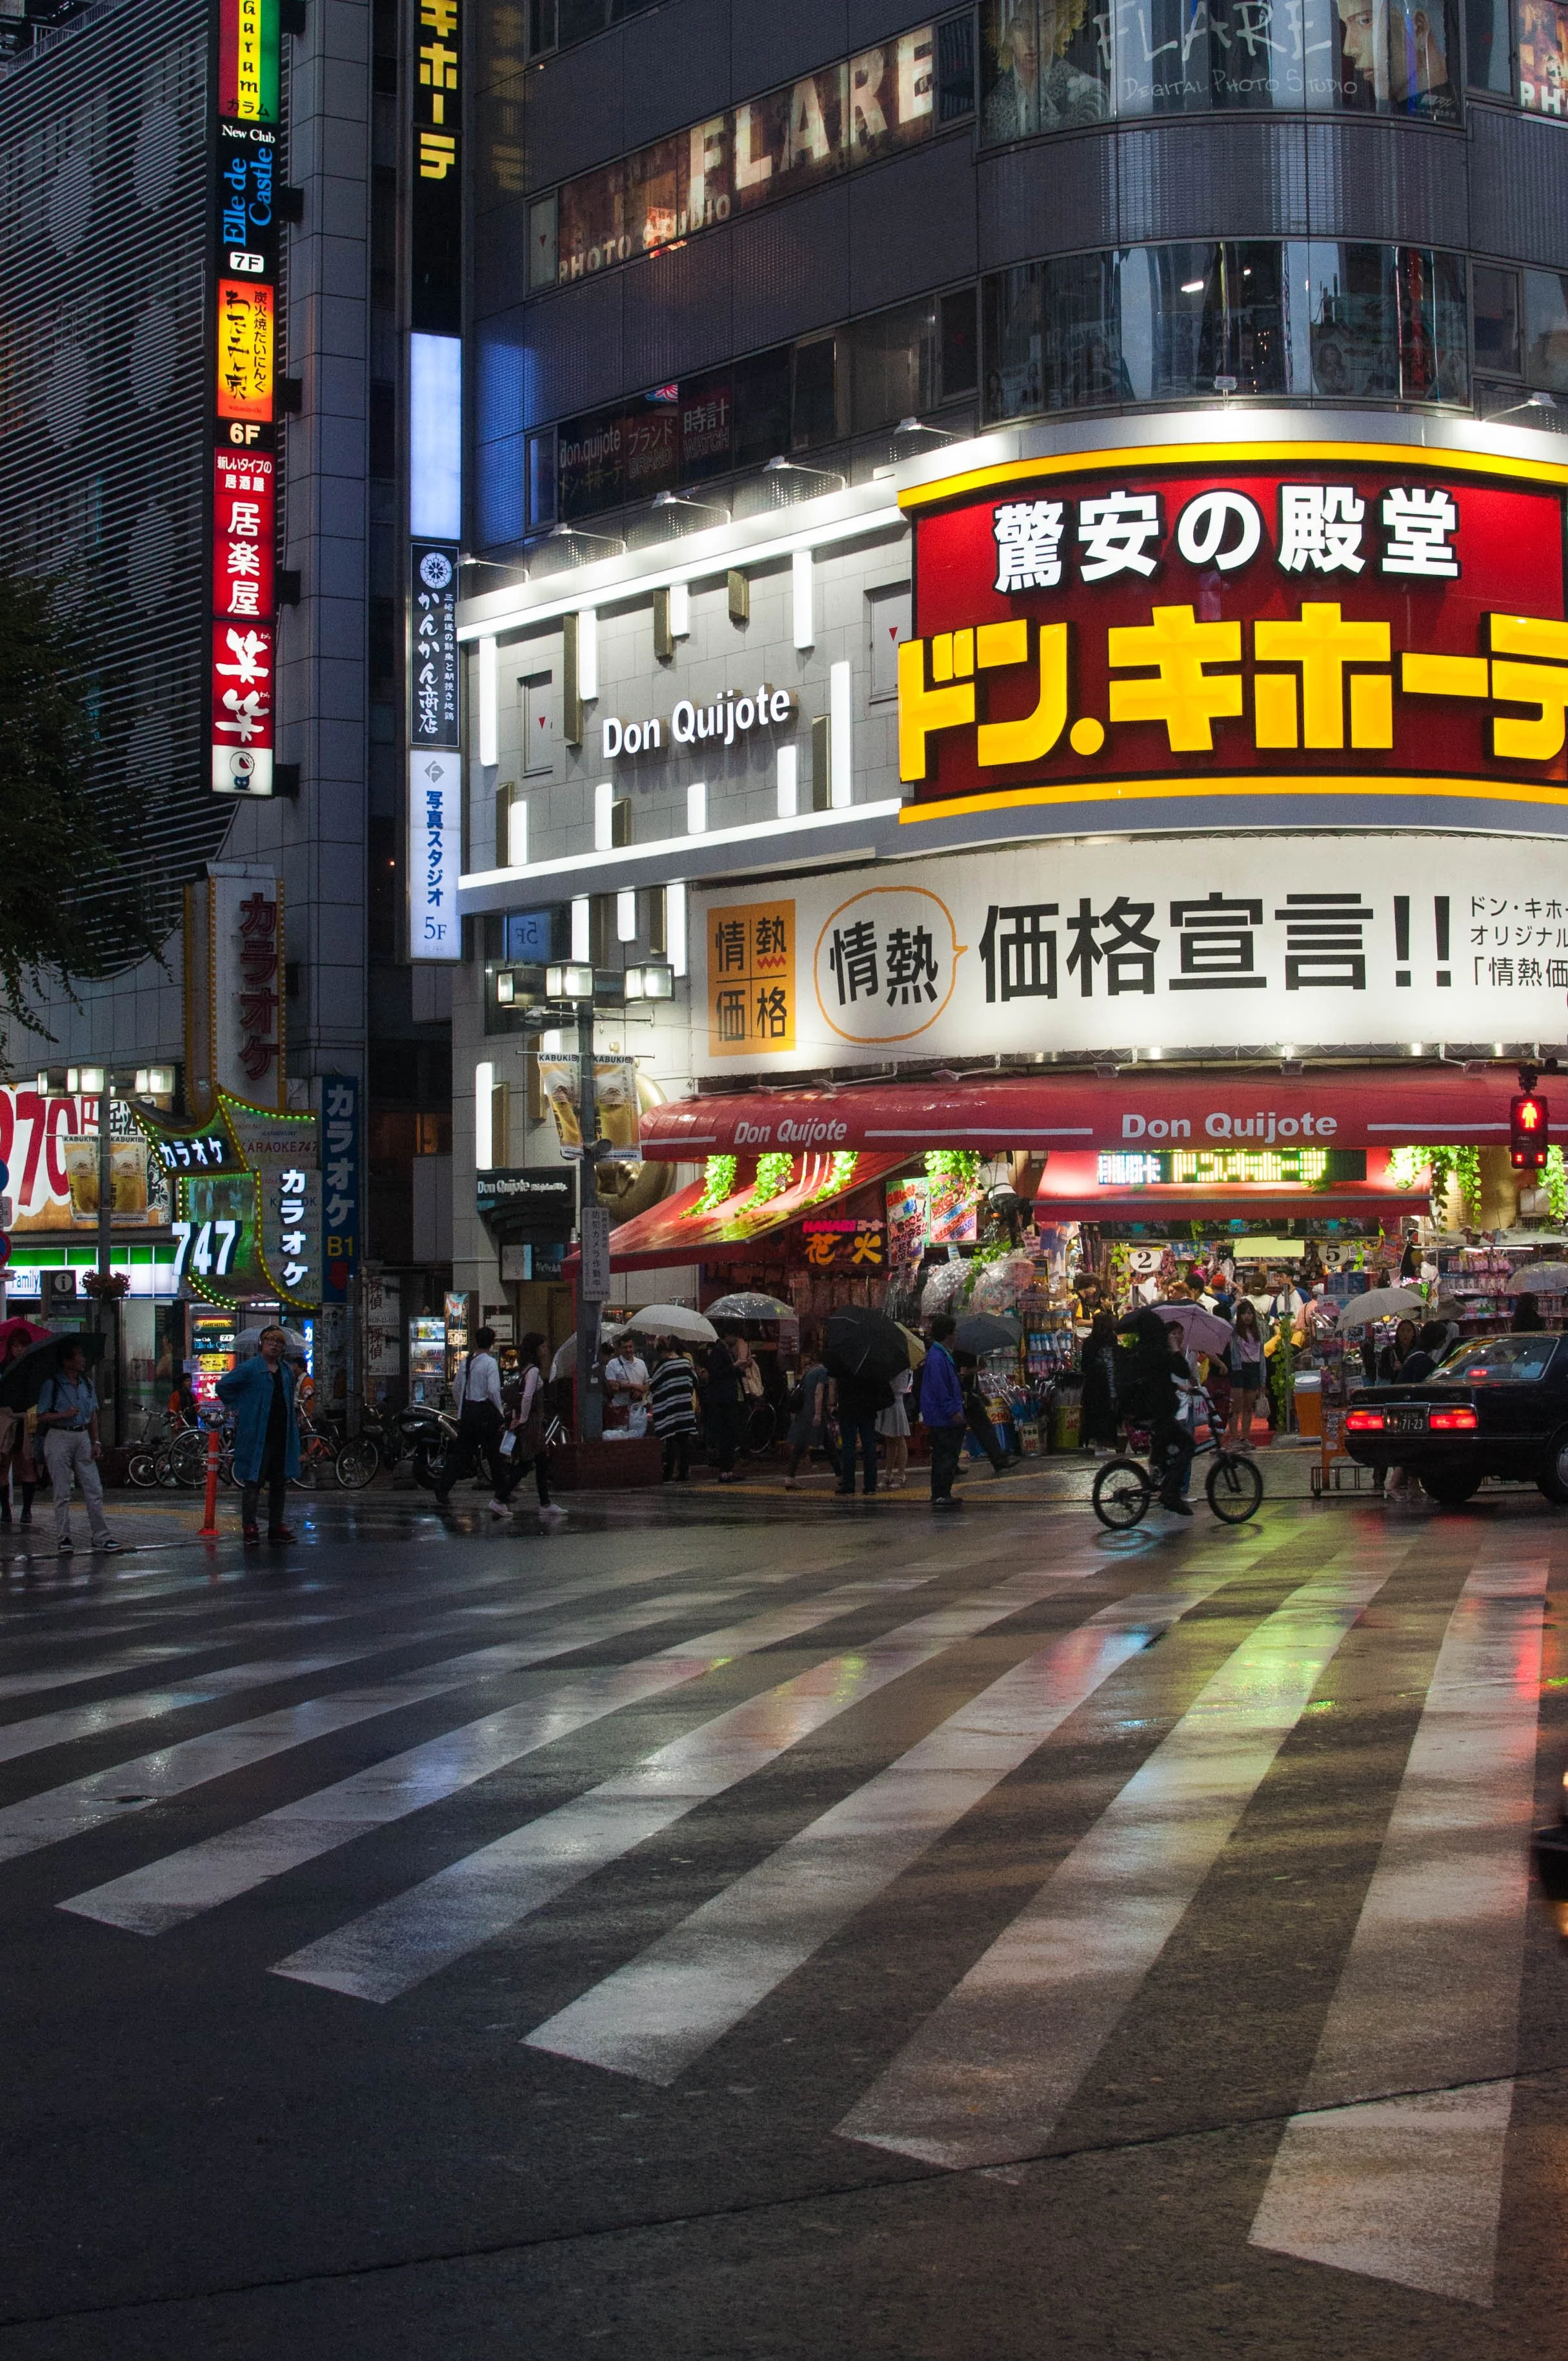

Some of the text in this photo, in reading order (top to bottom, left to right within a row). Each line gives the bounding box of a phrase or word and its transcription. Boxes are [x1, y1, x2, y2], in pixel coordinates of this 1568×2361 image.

[239, 0, 258, 94] Garam
[1091, 0, 1332, 70] FLARE
[1212, 70, 1279, 95] PHOTO
[1286, 69, 1358, 94] STUDIO
[1520, 81, 1568, 115] PH
[227, 97, 270, 117] ガラム
[689, 25, 934, 208] FLARE
[221, 125, 276, 143] New Club
[223, 158, 246, 246] Elle de
[248, 148, 273, 226] Castle
[234, 254, 261, 272] 7F
[559, 235, 632, 285] PHOTO
[225, 290, 251, 400] わたみん家
[254, 291, 267, 393] 炭火焼だいにんぐ
[683, 397, 730, 434] 時計
[230, 423, 261, 445] 6F
[628, 419, 674, 456] ブランド
[681, 428, 730, 461] WATCH
[217, 456, 272, 474] 新しいタイプの
[628, 447, 672, 479] BRAND
[225, 474, 265, 492] 居酒屋
[993, 484, 1460, 593] 驚安の殿堂
[227, 501, 261, 616] 居楽屋
[418, 592, 440, 734] かんかん商店
[215, 627, 269, 743] 笑笑
[603, 685, 790, 759] Don Quijote
[426, 790, 444, 907] 写真スタジオ
[1471, 896, 1568, 919] ドン・キホ
[423, 916, 447, 940] 5F
[714, 915, 787, 972] 情熱
[1470, 925, 1568, 948] オリジナル
[829, 920, 940, 1007] 情熱
[239, 892, 280, 1081] カラオケ
[716, 985, 788, 1043] 価格
[733, 1118, 847, 1147] Don Quijote
[1121, 1110, 1338, 1143] Don Quijote
[159, 1137, 222, 1167] カラオケ
[326, 1083, 355, 1227] カラオケ
[477, 1180, 496, 1194] Don
[496, 1180, 530, 1195] Quijote
[280, 1169, 308, 1287] カラオケ
[172, 1220, 236, 1276] 747
[327, 1235, 354, 1257] B1
[805, 1232, 883, 1266] 花火
[1137, 1251, 1153, 1270] 2
[1326, 1245, 1340, 1263] 5
[12, 1270, 42, 1293] Family
[369, 1278, 383, 1309] 探偵
[369, 1327, 383, 1360] 探偵
[1402, 1418, 1423, 1430] 71-23
